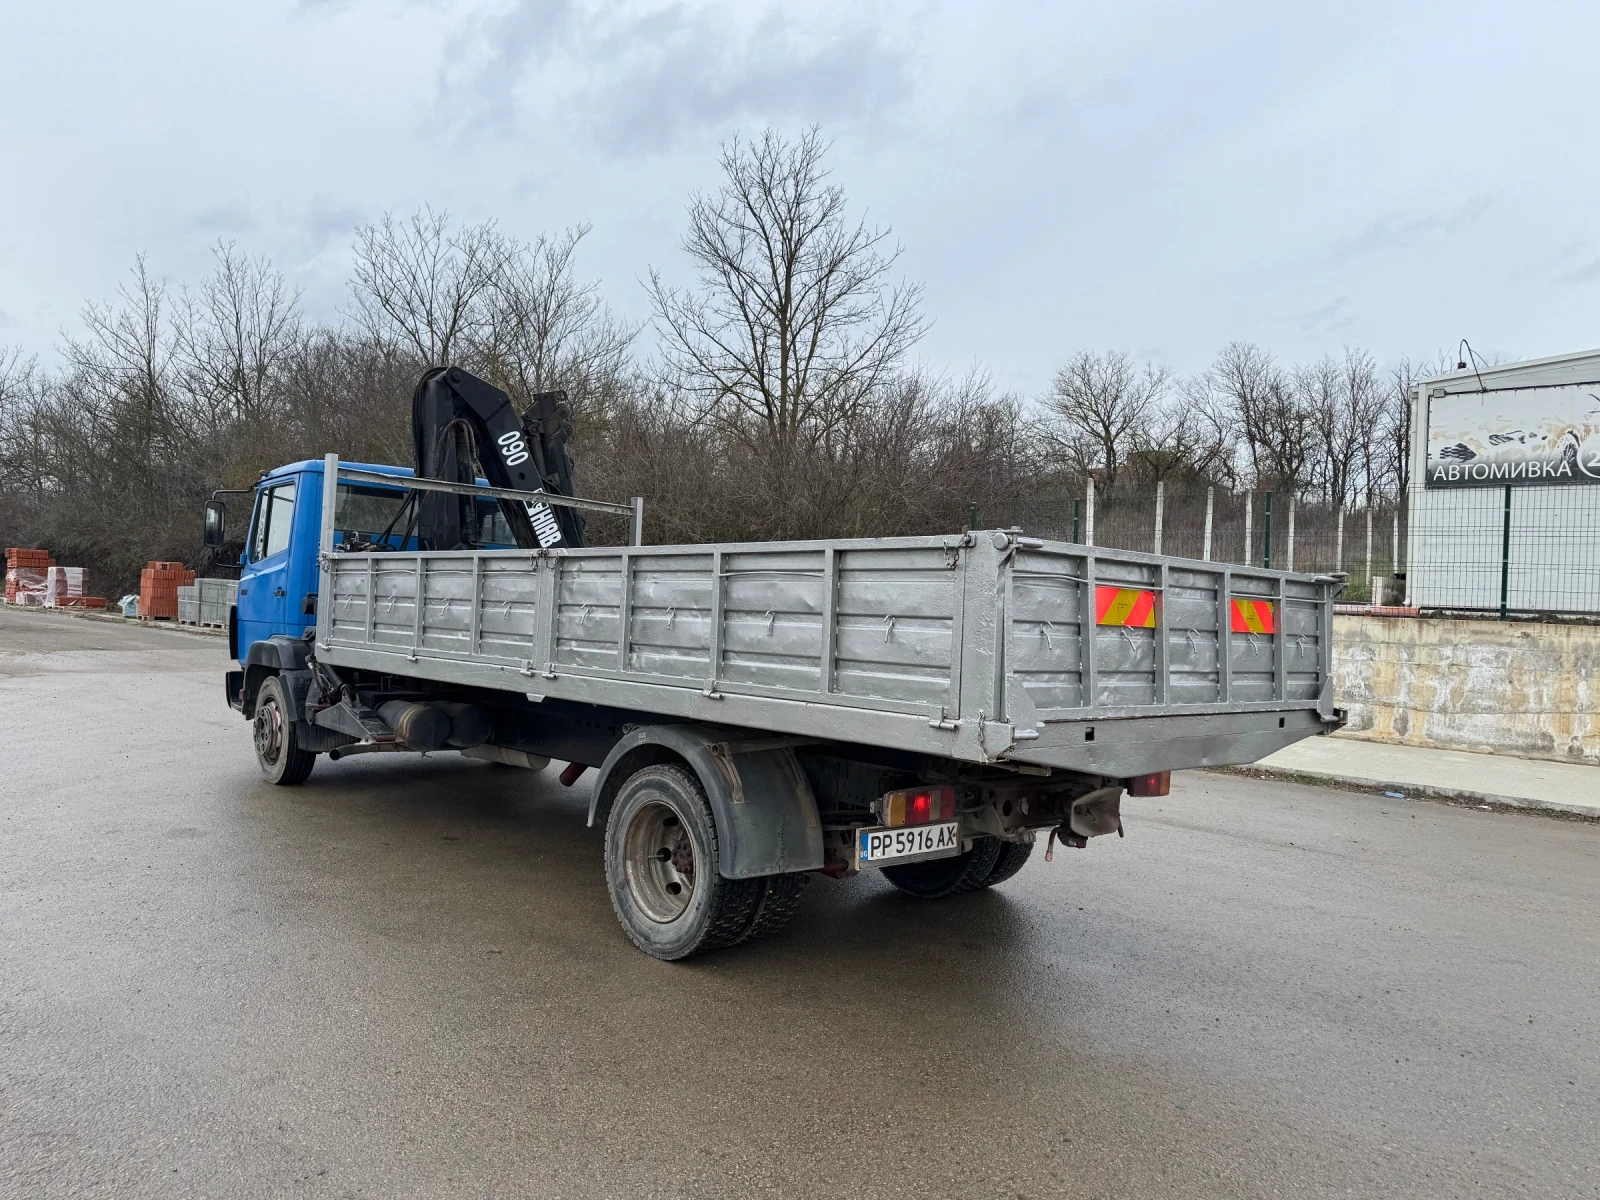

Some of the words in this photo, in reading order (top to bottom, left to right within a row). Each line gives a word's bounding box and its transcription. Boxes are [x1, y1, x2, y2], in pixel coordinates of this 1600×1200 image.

[498, 431, 528, 466] 090
[1433, 460, 1572, 481] АВТОМИВКА
[530, 508, 562, 548] HIAB
[871, 834, 892, 857] PP
[896, 829, 933, 853] 5916
[937, 826, 955, 848] AX
